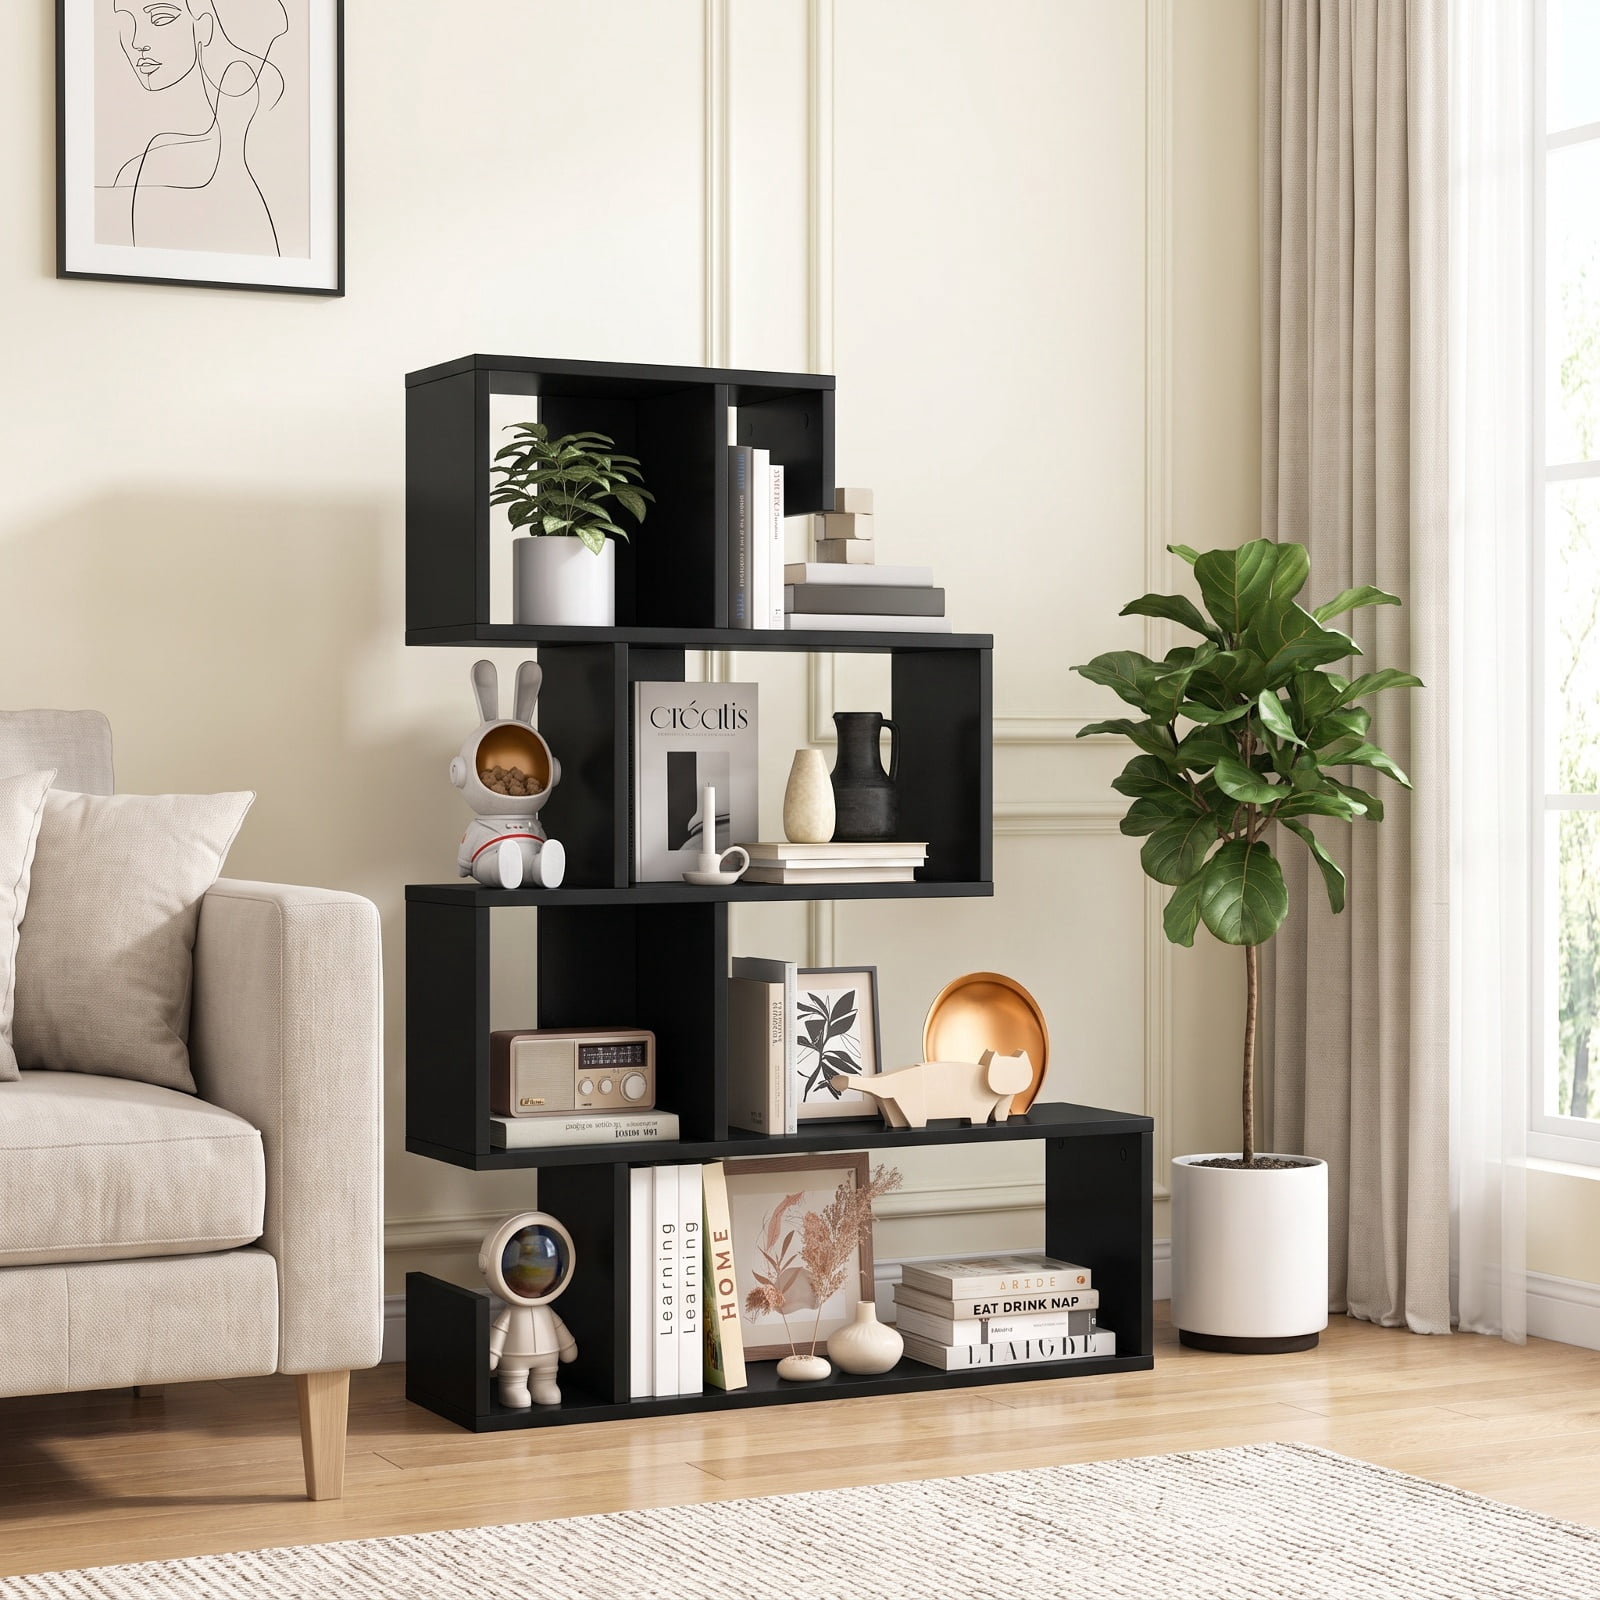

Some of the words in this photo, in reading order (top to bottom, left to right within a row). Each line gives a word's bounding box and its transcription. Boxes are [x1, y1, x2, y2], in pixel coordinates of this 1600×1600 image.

[660, 1224, 675, 1335] Learning
[683, 1222, 699, 1333] Learning
[713, 1229, 737, 1321] HOME
[973, 1303, 999, 1316] EAT
[1003, 1298, 1047, 1313] DRINK
[1051, 1296, 1080, 1309] NAP
